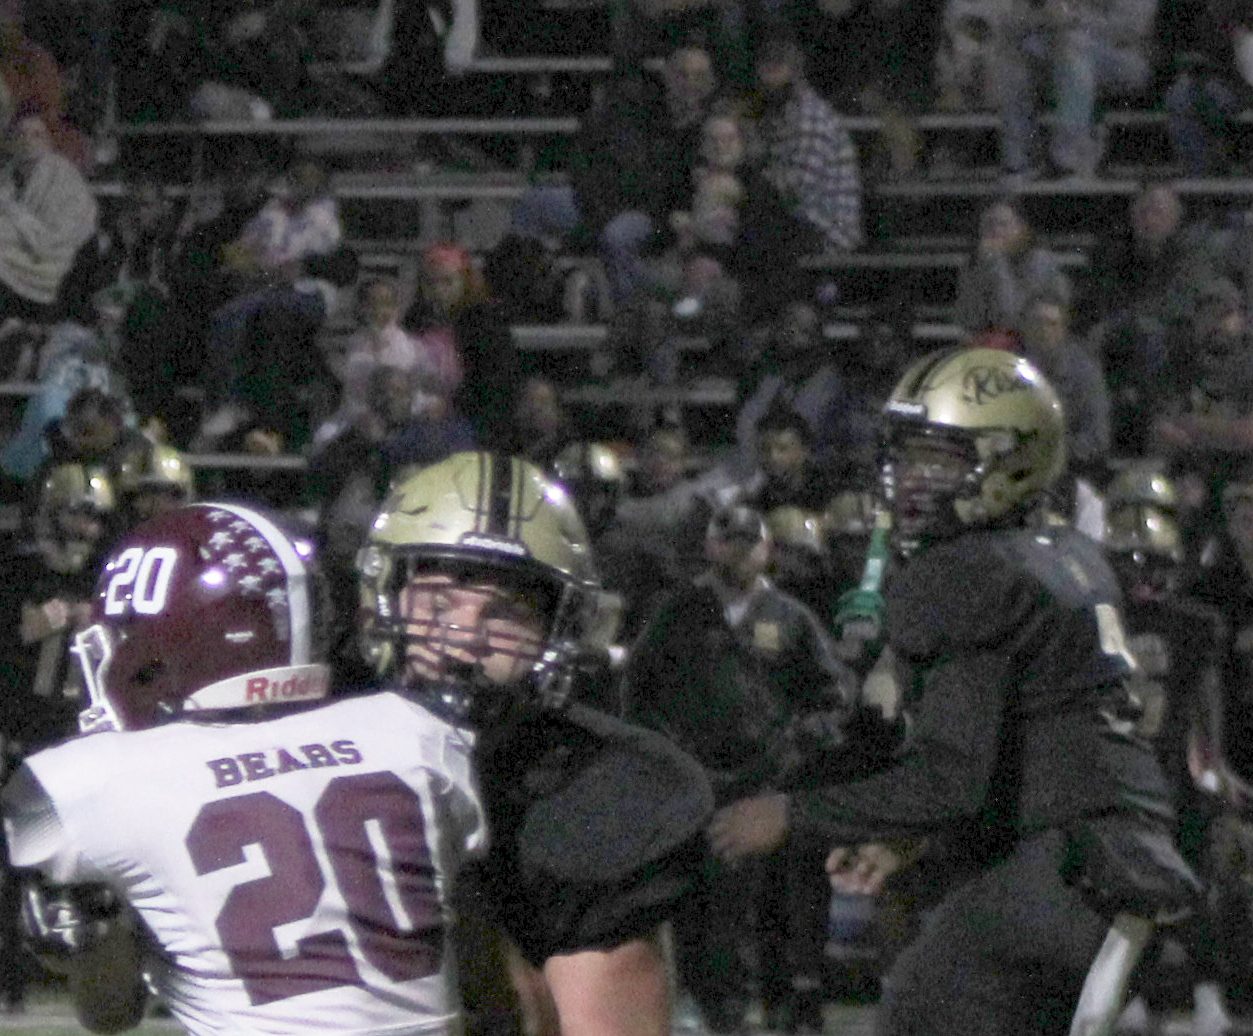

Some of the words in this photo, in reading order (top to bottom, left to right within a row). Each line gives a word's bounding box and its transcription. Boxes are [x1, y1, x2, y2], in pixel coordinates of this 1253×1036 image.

[105, 546, 178, 615] 20
[246, 674, 329, 702] Ridd
[206, 739, 364, 788] BEARS
[184, 769, 446, 1007] 20
